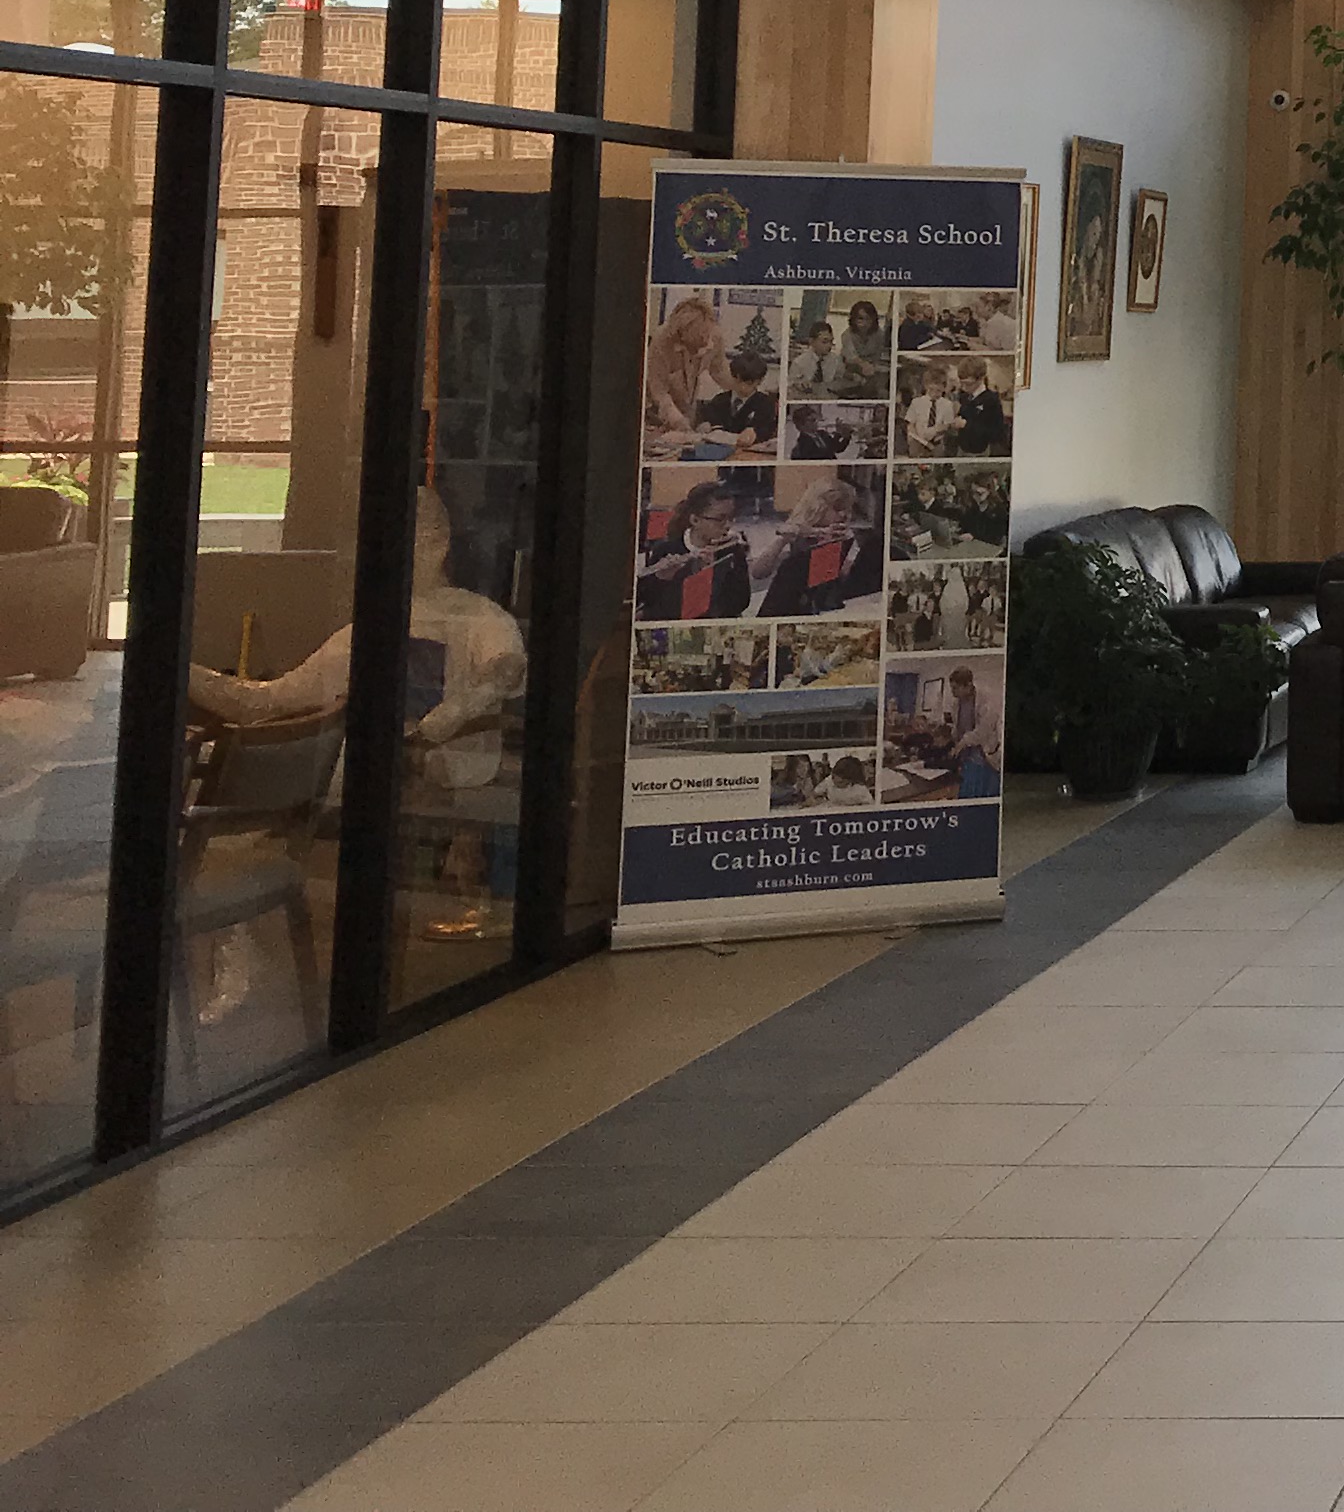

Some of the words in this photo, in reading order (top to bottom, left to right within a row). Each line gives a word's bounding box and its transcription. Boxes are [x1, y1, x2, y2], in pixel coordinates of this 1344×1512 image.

[763, 221, 797, 242] St.
[807, 220, 909, 244] Theresa
[918, 224, 1003, 246] School
[764, 264, 841, 281] Ashburn,
[845, 266, 912, 284] Virginia
[631, 781, 668, 791] Victor
[669, 777, 713, 790] O'Neill
[715, 776, 760, 787] Studios
[669, 822, 801, 846] Educating
[810, 812, 960, 837] Tomorrow's
[711, 847, 821, 871] Catholic
[831, 840, 928, 863] Leaders
